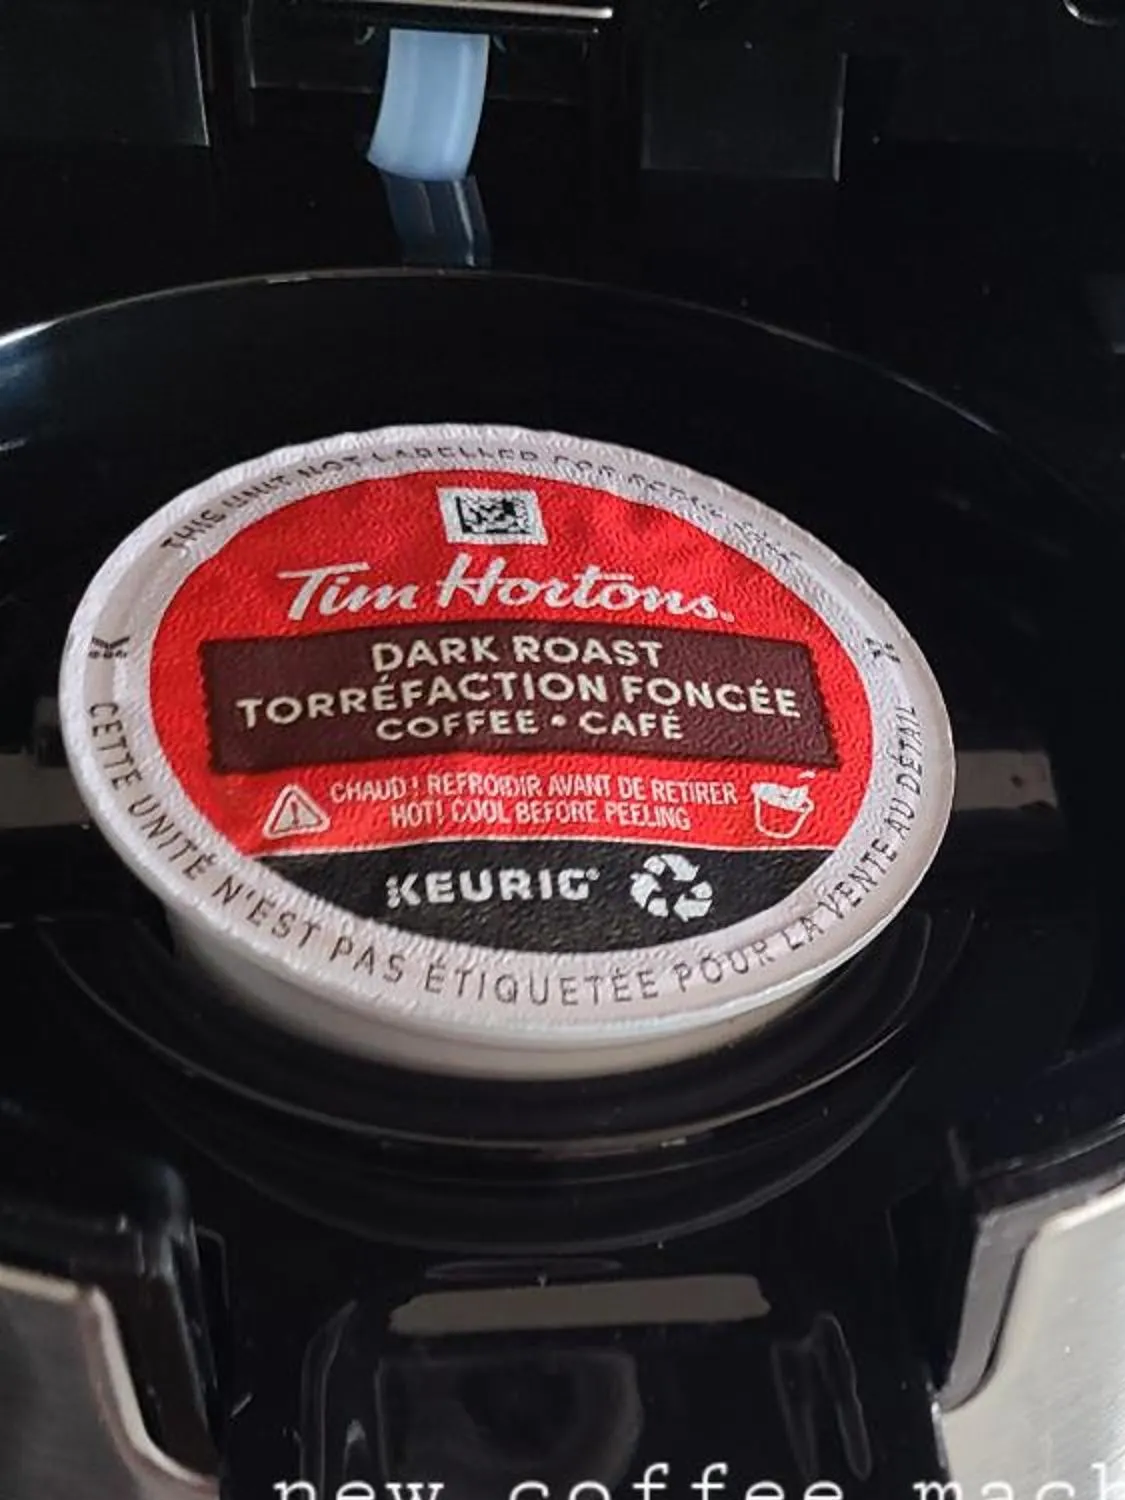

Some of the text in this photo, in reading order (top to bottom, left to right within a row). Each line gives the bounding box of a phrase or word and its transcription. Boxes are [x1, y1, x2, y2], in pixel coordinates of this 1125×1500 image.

[160, 509, 226, 551] THIS
[296, 454, 362, 481] NOT
[277, 552, 719, 622] Tim Hortons
[371, 633, 663, 673] DARK ROAST
[236, 671, 802, 728] TORRÉFACTION FONCÉE
[375, 708, 684, 741] COFFEE CAFÉ
[427, 773, 541, 799] REFROIDIR
[548, 774, 612, 798] AVANT
[617, 775, 646, 799] DE
[651, 776, 738, 804] RETIRER
[391, 801, 691, 831] HOT! COOL BEFORE PEELING
[89, 703, 925, 1007] CETTE UNITÉ N'EST PAS ÉTIQUETÉE POUR LA VENTE AU DÉTAIL
